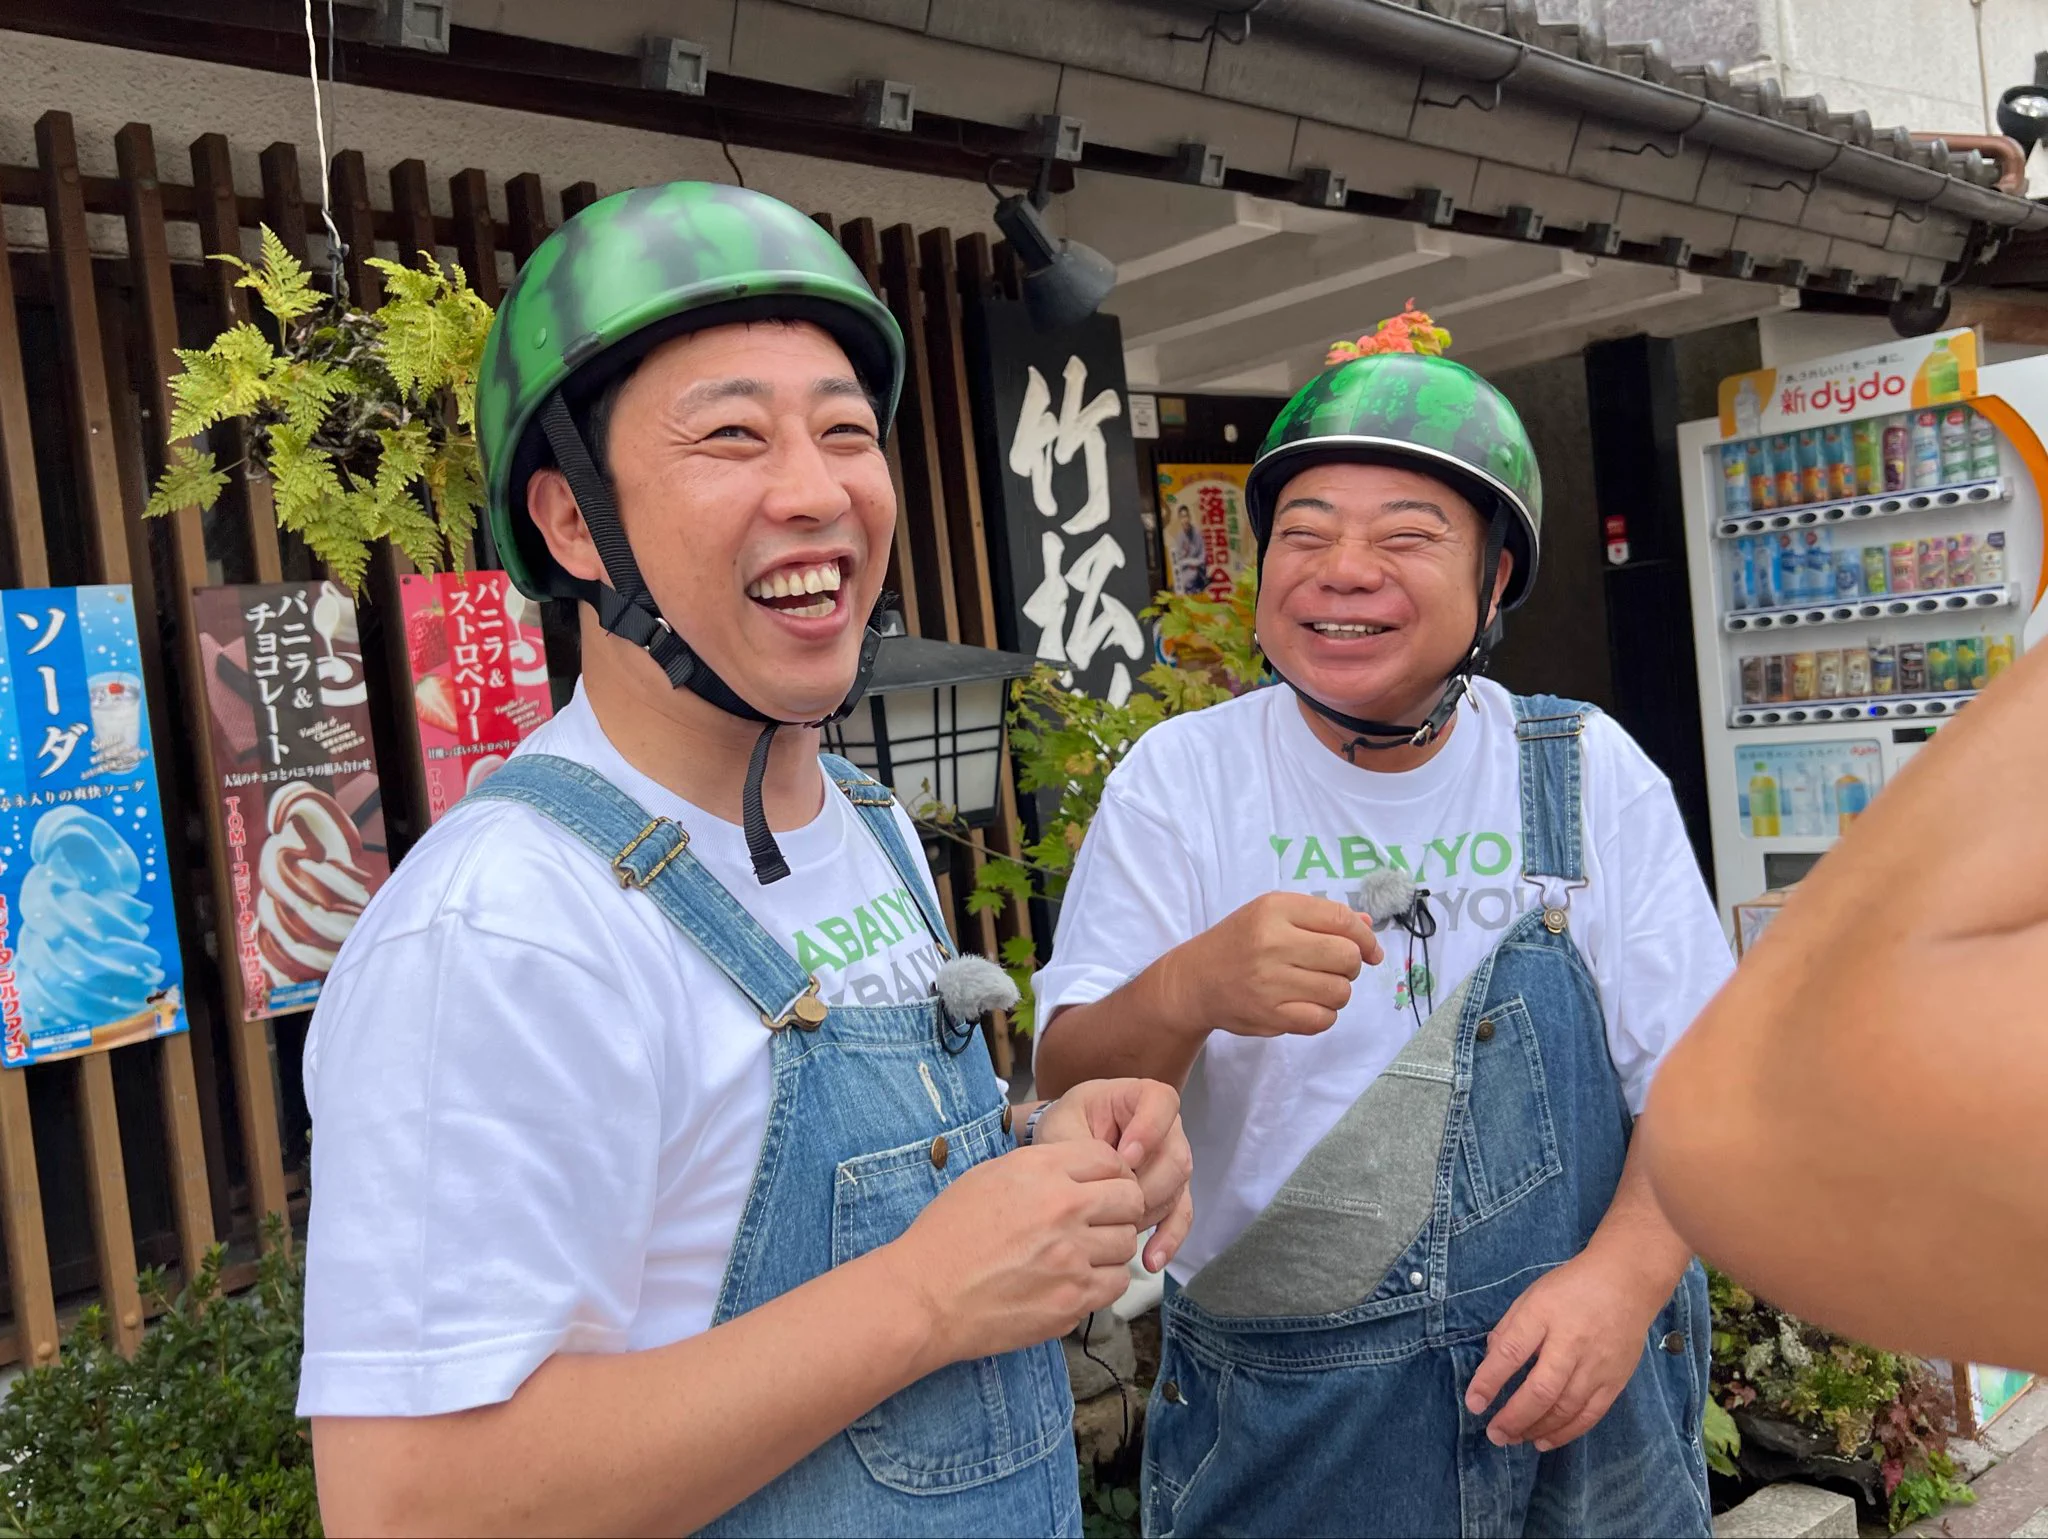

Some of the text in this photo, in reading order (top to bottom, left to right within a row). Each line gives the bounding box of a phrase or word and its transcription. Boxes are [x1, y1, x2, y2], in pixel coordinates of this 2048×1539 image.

[1009, 354, 1145, 715] 竹松
[16, 607, 89, 779] ソーダ
[245, 602, 290, 766] チョコレート
[276, 589, 314, 709] バニラ&
[449, 591, 485, 742] ストロベリー
[475, 578, 507, 688] バニラ&
[428, 739, 527, 759] 甘酸っぱいストロベリー
[430, 768, 448, 818] TOM
